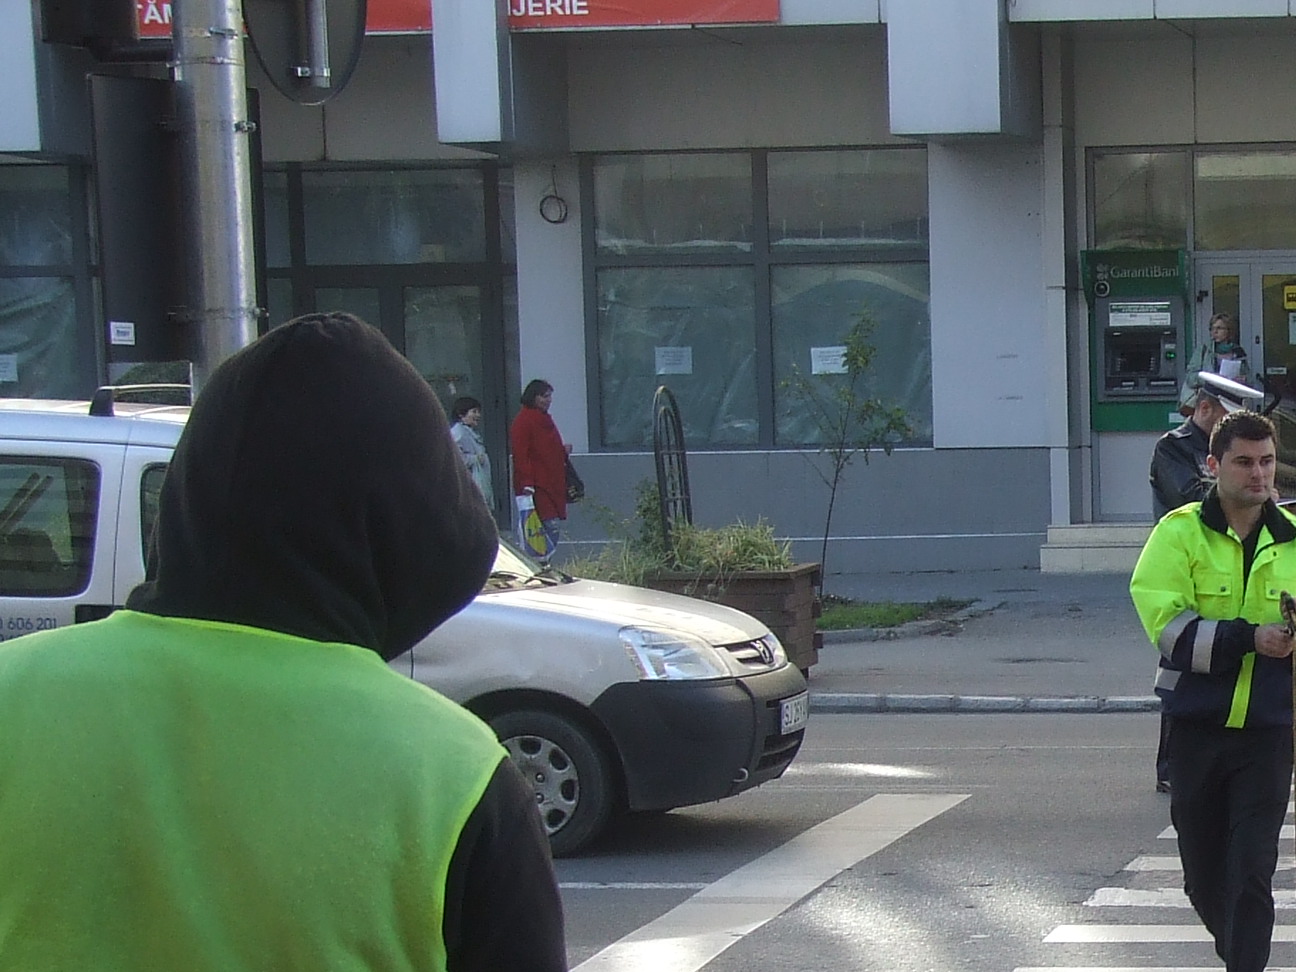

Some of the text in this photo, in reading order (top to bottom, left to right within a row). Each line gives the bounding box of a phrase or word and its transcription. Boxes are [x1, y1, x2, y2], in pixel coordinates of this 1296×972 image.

[507, 0, 589, 16] JERIE
[7, 617, 33, 630] 606
[36, 617, 57, 631] 201
